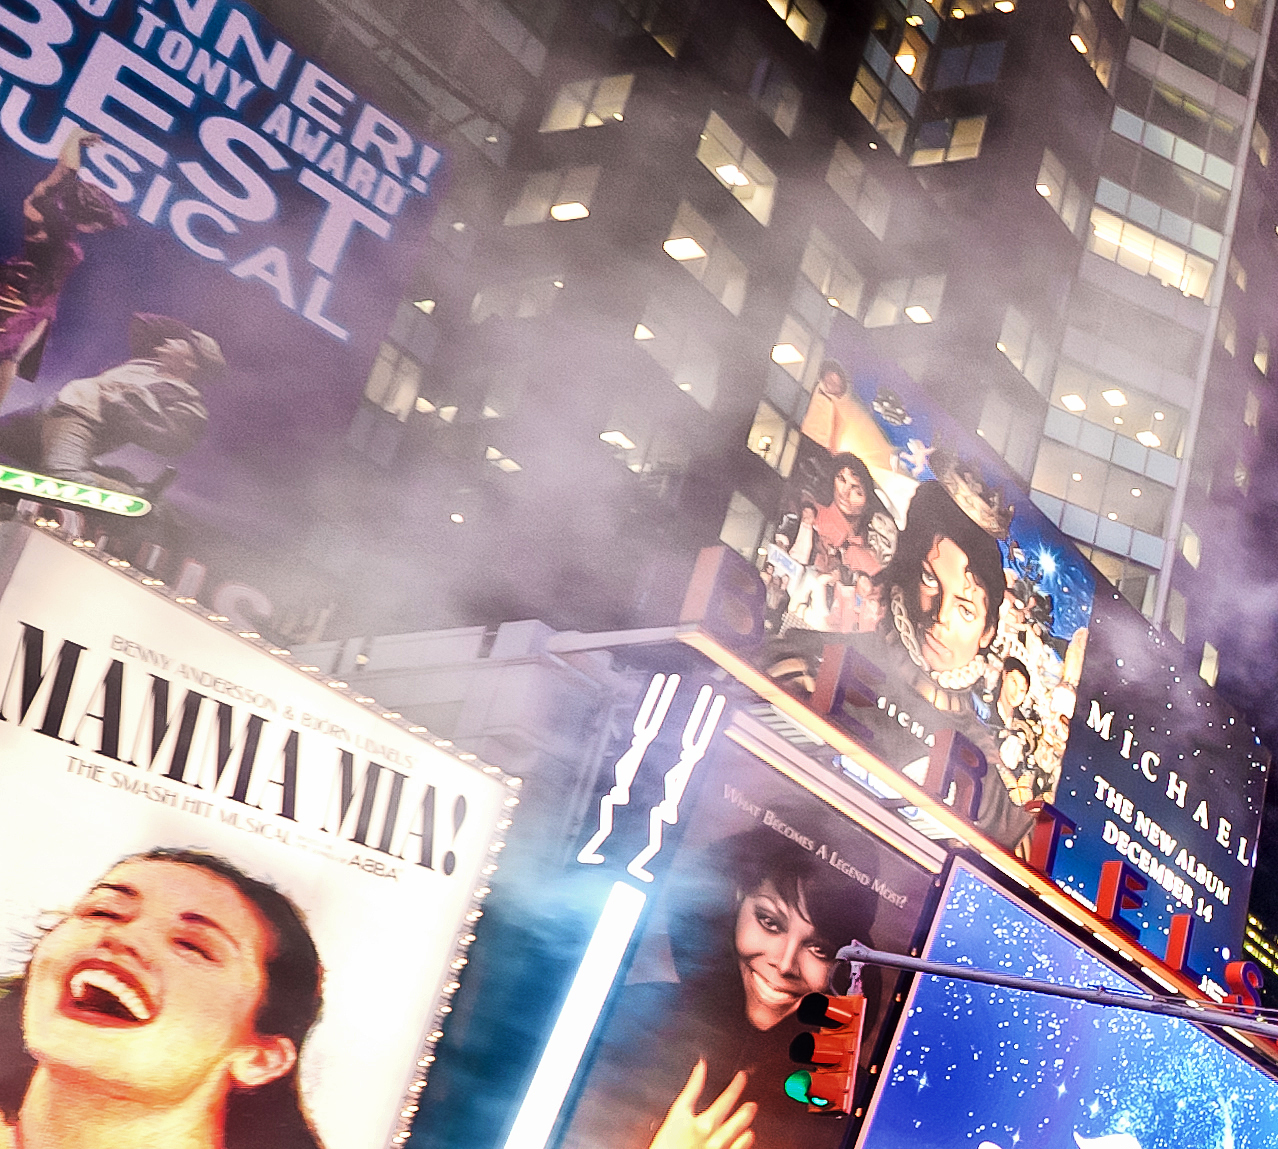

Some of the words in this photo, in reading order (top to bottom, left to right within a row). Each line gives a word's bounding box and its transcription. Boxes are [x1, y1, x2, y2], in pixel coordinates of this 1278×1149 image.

[0, 0, 393, 274] BEST
[133, 8, 256, 110] TONY
[260, 103, 406, 216] AWARD
[0, 620, 302, 822] MAMMA
[320, 748, 470, 877] MIA!
[282, 704, 295, 720] &
[65, 753, 107, 783] THE
[110, 768, 177, 808] SMASH
[181, 796, 214, 819] HIT
[219, 806, 290, 847] MUSICAL
[723, 783, 756, 817] WHAT
[762, 809, 814, 851] BECOMES
[815, 842, 829, 859] A
[828, 850, 870, 886] LEGEND
[870, 876, 908, 910] MOST?
[1086, 699, 1250, 869] MICHAEL
[1093, 775, 1135, 822] THE
[1135, 809, 1178, 857] NEW
[1174, 848, 1231, 906] ALBUM
[1101, 819, 1195, 910] DECEMBER
[1196, 896, 1214, 923] 14
